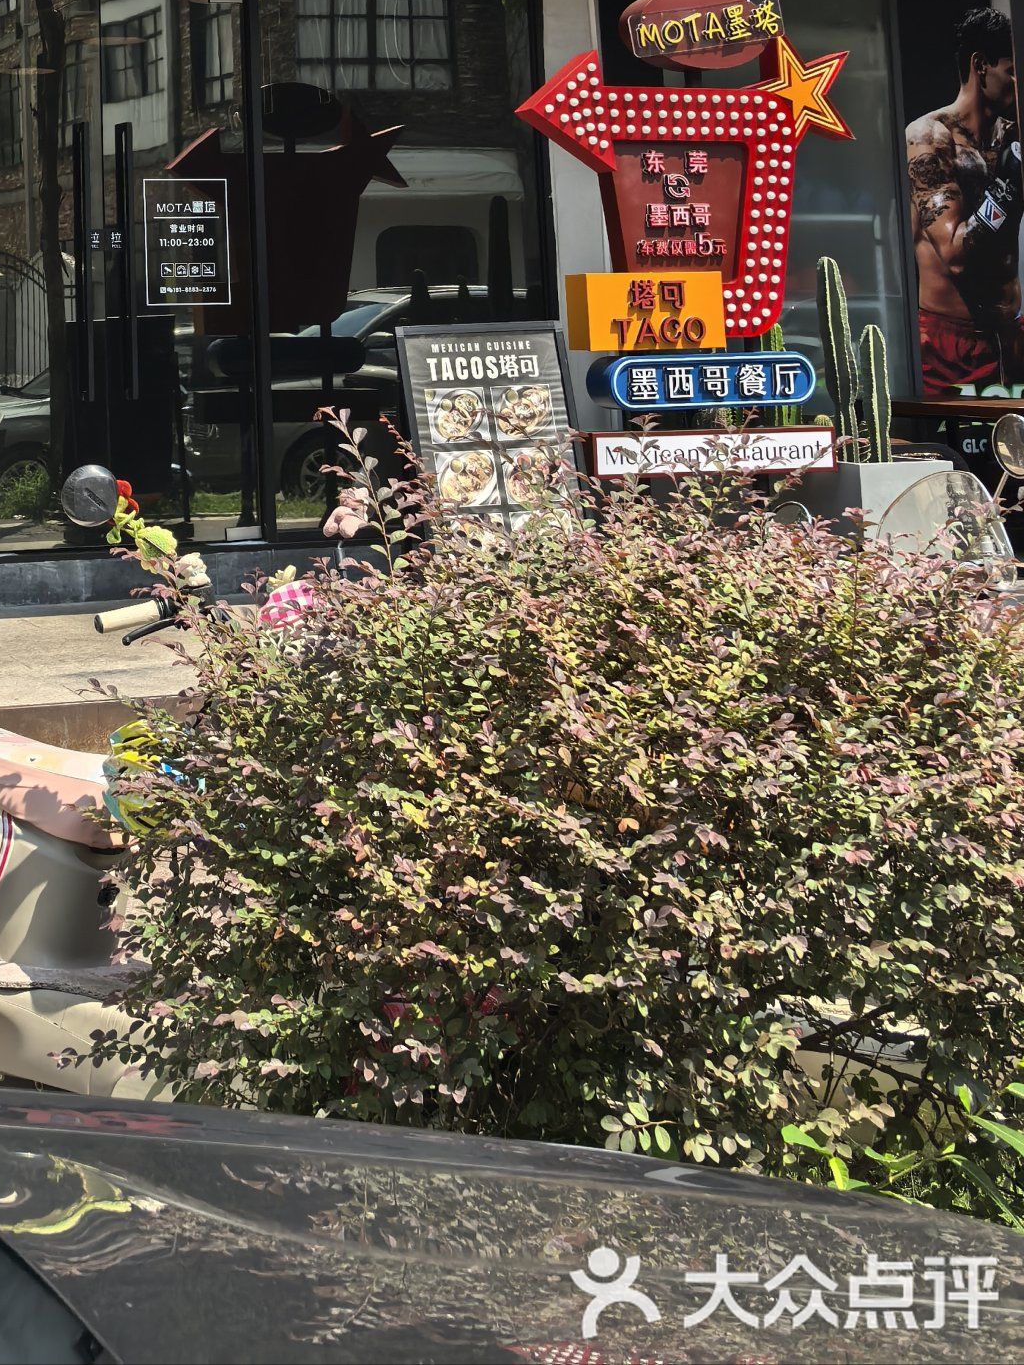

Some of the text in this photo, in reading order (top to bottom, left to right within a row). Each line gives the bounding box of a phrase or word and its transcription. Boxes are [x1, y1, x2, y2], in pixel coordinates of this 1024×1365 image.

[646, 202, 712, 227] 墨西哥
[169, 223, 205, 234] 营业时间
[630, 279, 687, 310] 塔可
[611, 316, 706, 344] TACO
[430, 340, 531, 354] MEXICAN CUISINE
[629, 363, 801, 401] 墨西哥餐厅
